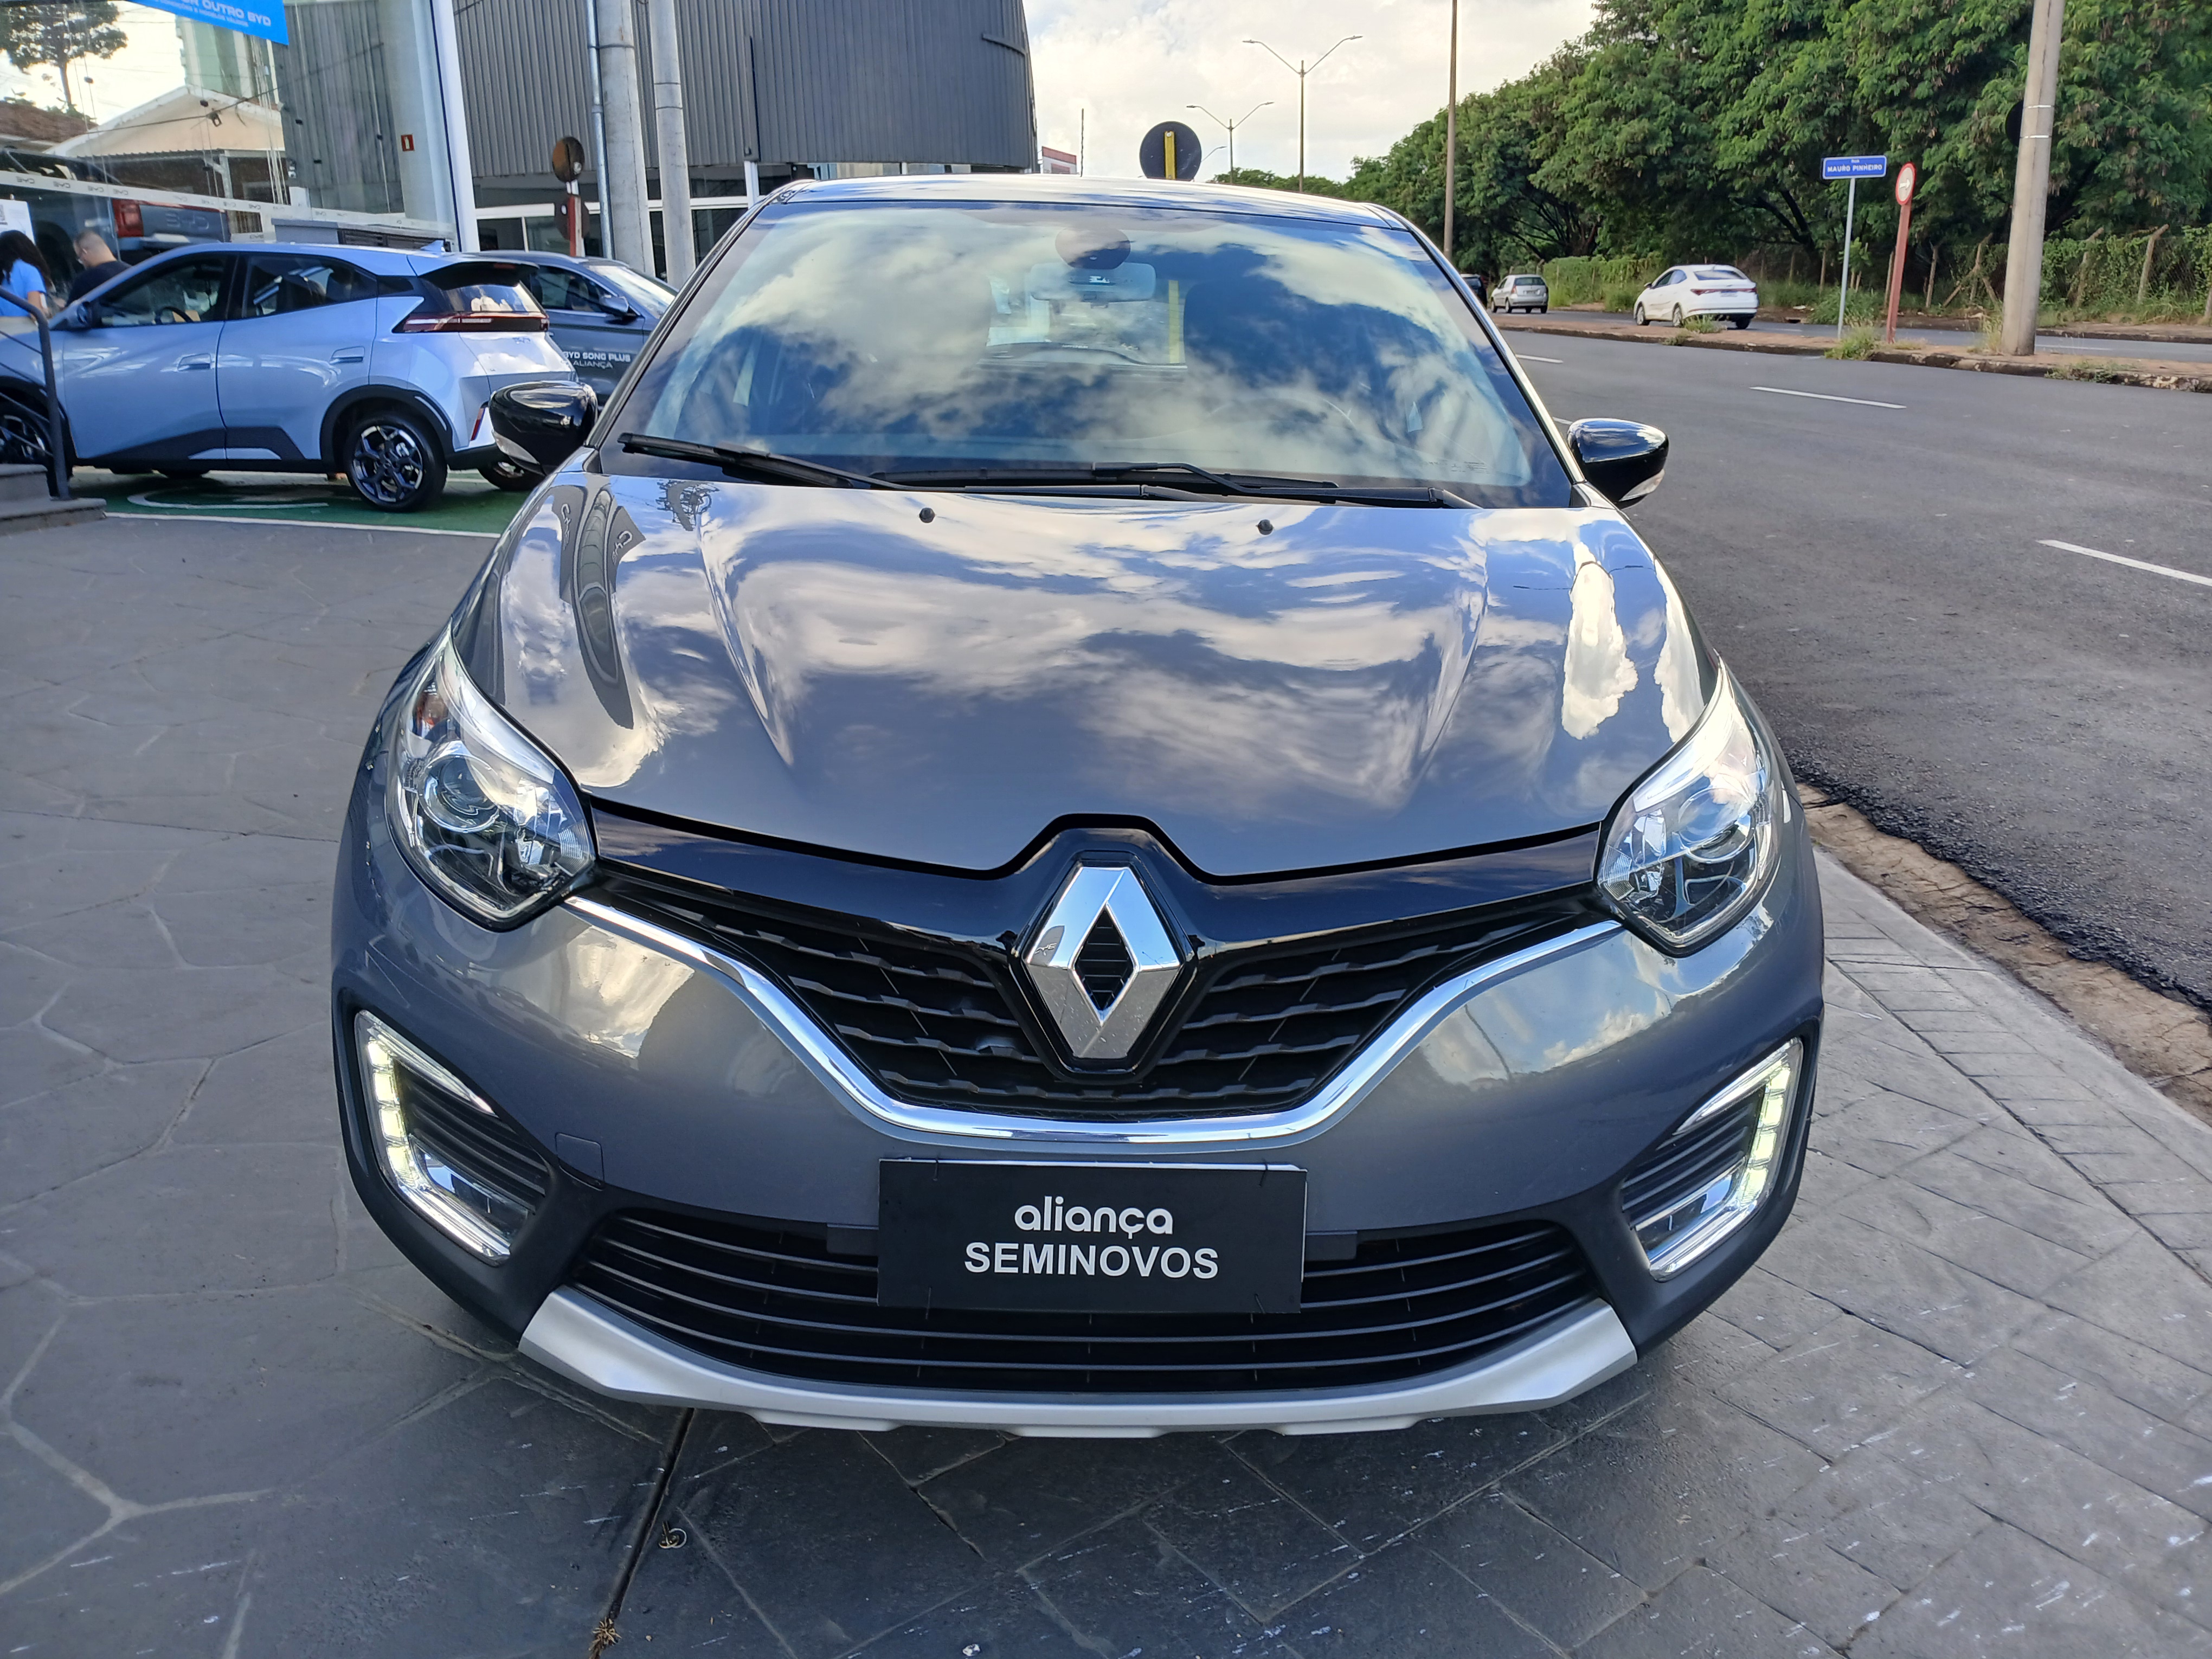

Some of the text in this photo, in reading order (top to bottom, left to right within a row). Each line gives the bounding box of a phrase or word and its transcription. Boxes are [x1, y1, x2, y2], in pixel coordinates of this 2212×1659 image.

[202, 0, 245, 19] OUTRO
[247, 11, 271, 27] BYD
[1852, 164, 1882, 172] PINHEIRO
[573, 360, 614, 369] ALIANÇA
[608, 352, 631, 363] PLUS
[1014, 1195, 1173, 1239] aliança
[964, 1242, 1219, 1279] SEMINOVOS
